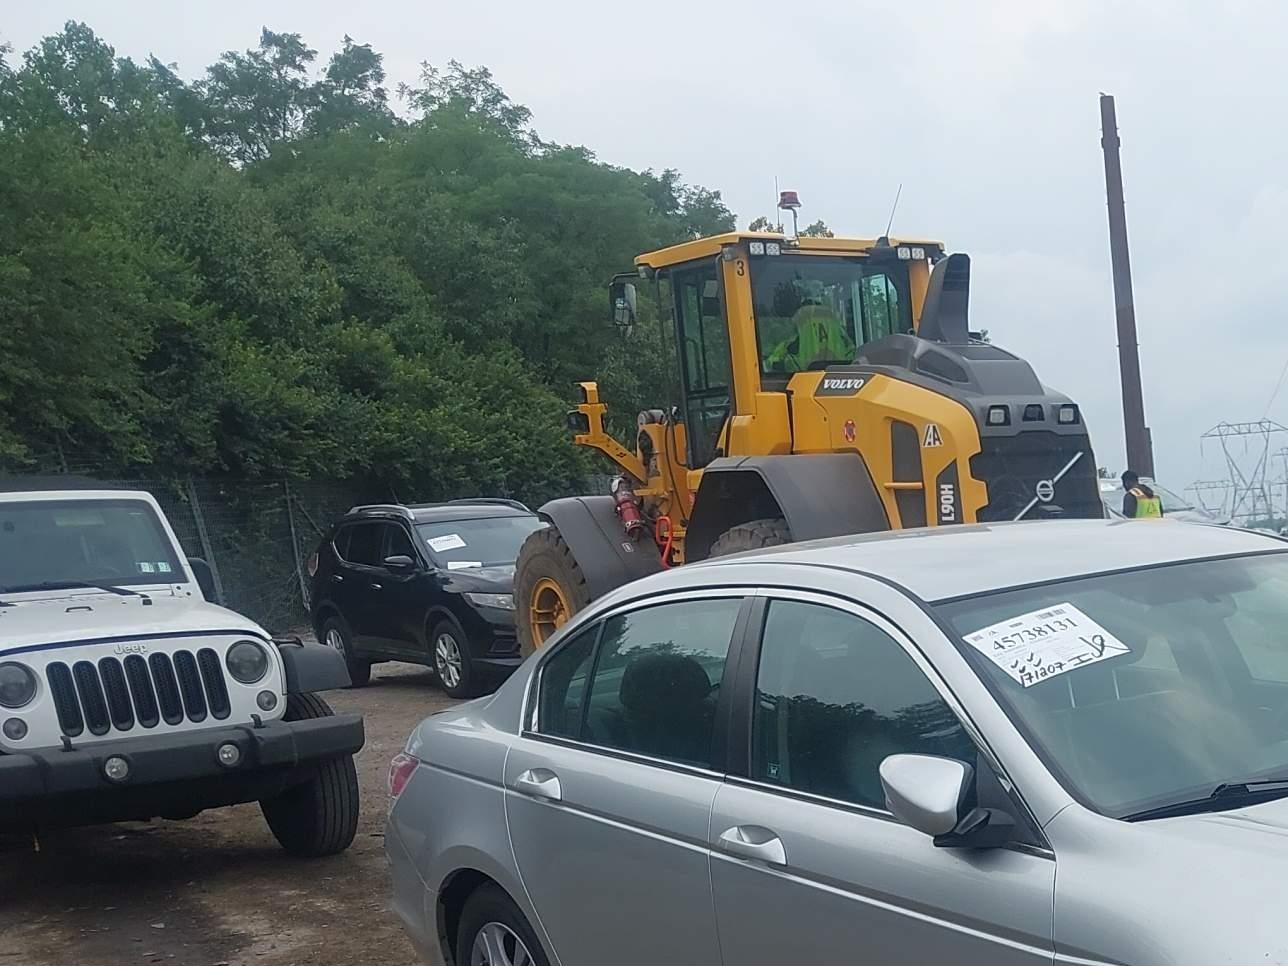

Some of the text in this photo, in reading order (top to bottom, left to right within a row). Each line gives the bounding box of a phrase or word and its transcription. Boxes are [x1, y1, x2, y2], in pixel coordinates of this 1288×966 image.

[736, 260, 745, 277] 3
[823, 378, 865, 389] VOLVO
[940, 484, 955, 521] L90H
[992, 617, 1078, 651] 45738131
[113, 643, 148, 655] Jeep
